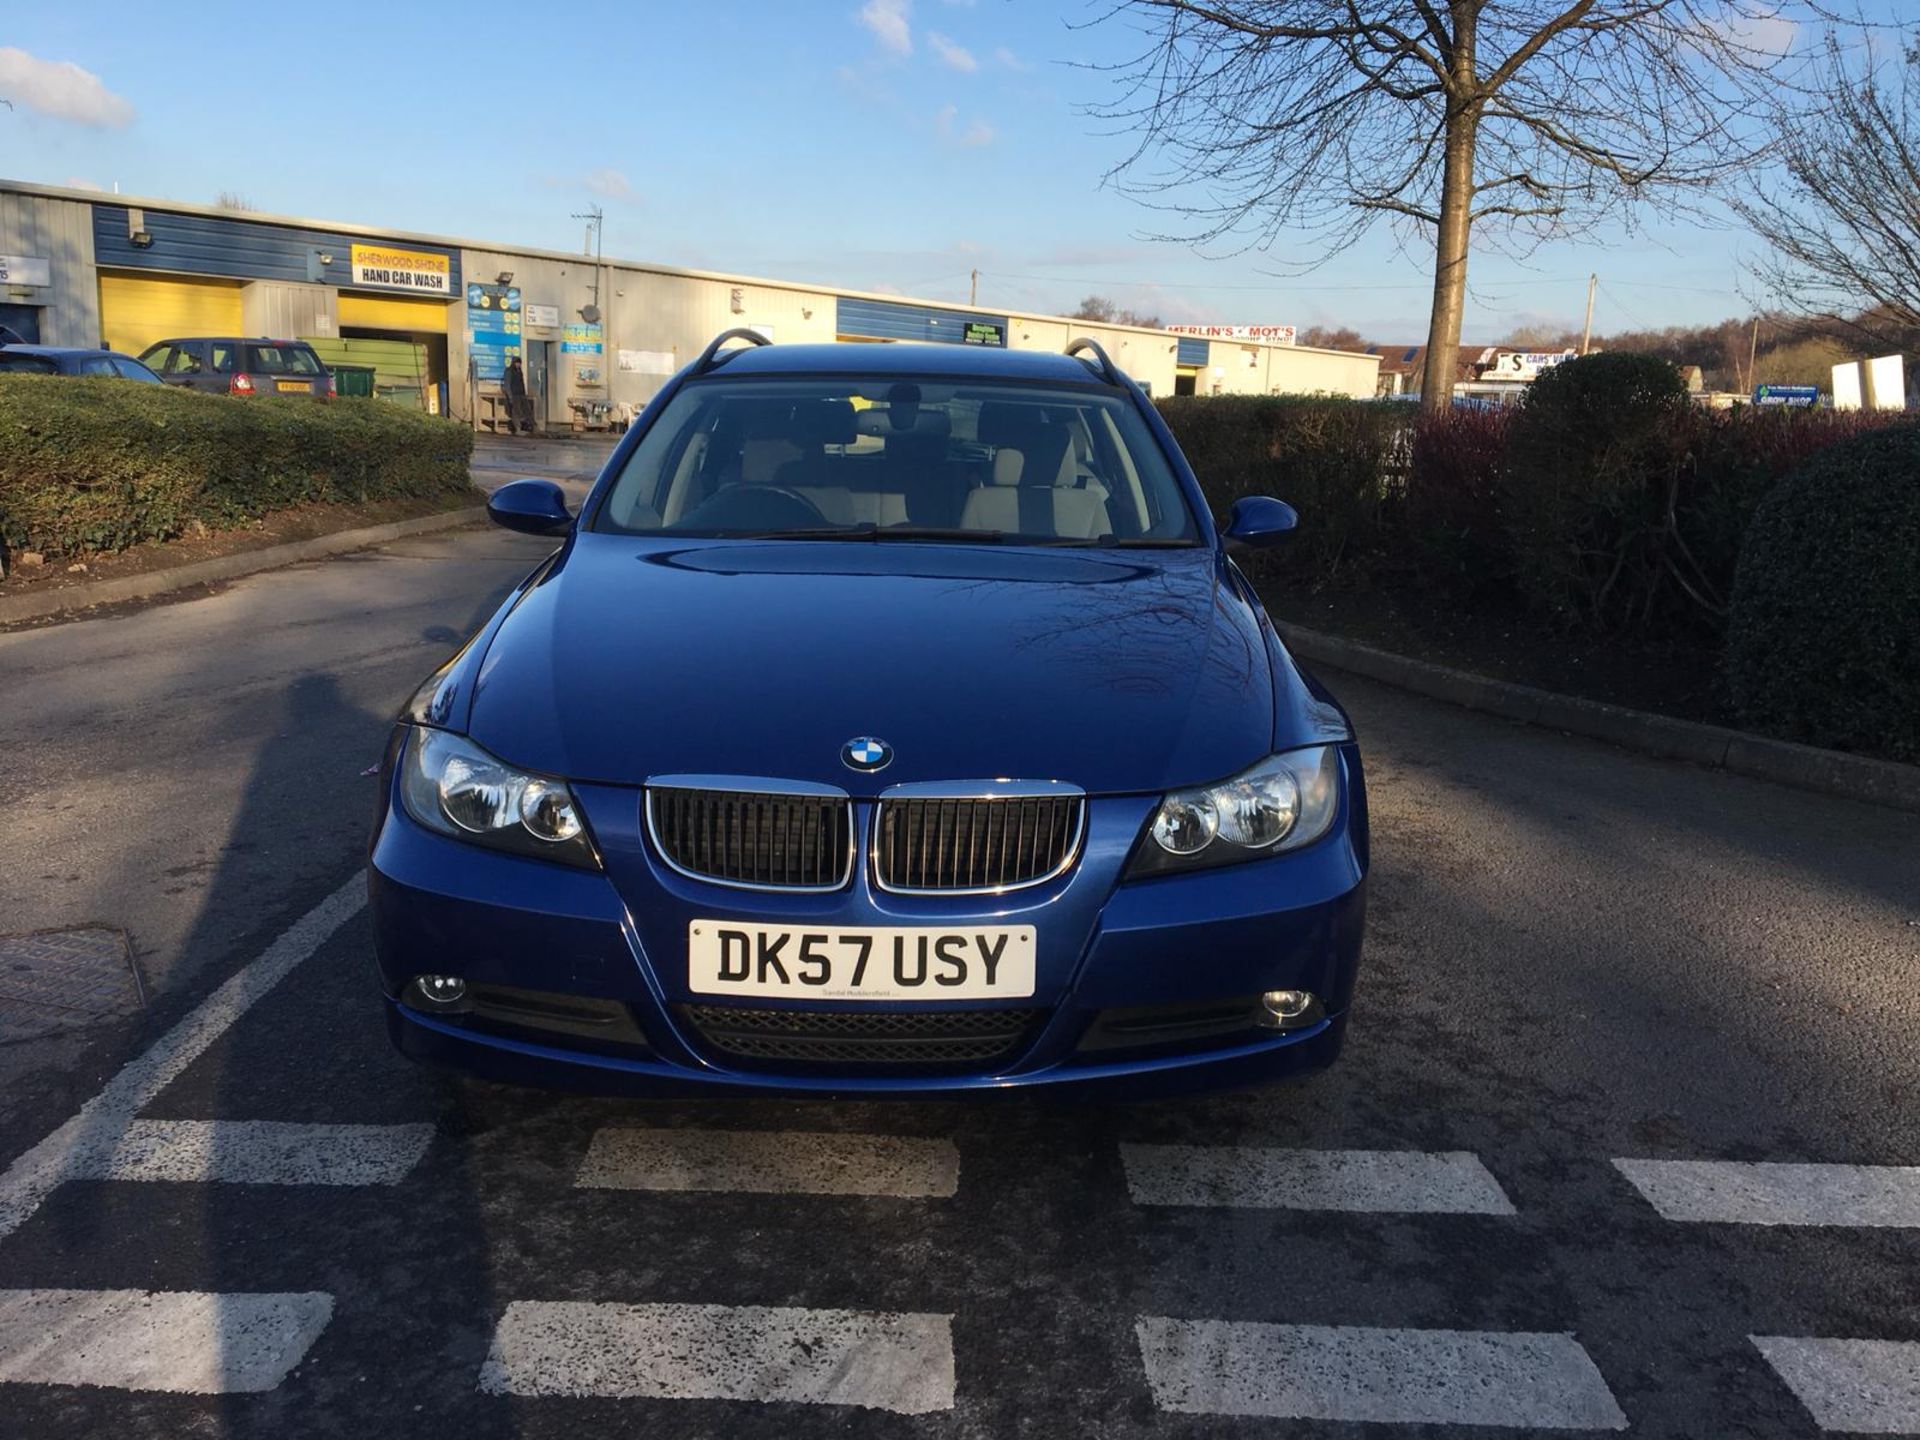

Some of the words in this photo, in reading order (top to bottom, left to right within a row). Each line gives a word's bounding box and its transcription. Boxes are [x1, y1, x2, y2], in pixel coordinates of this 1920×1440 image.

[358, 252, 413, 268] SHERWOOD
[414, 259, 445, 272] SHINE
[362, 268, 390, 283] HAND
[391, 271, 412, 285] CAR
[413, 273, 443, 288] WASH
[1760, 396, 1786, 405] GROW
[717, 929, 873, 987] DK57
[893, 934, 1009, 987] USY
